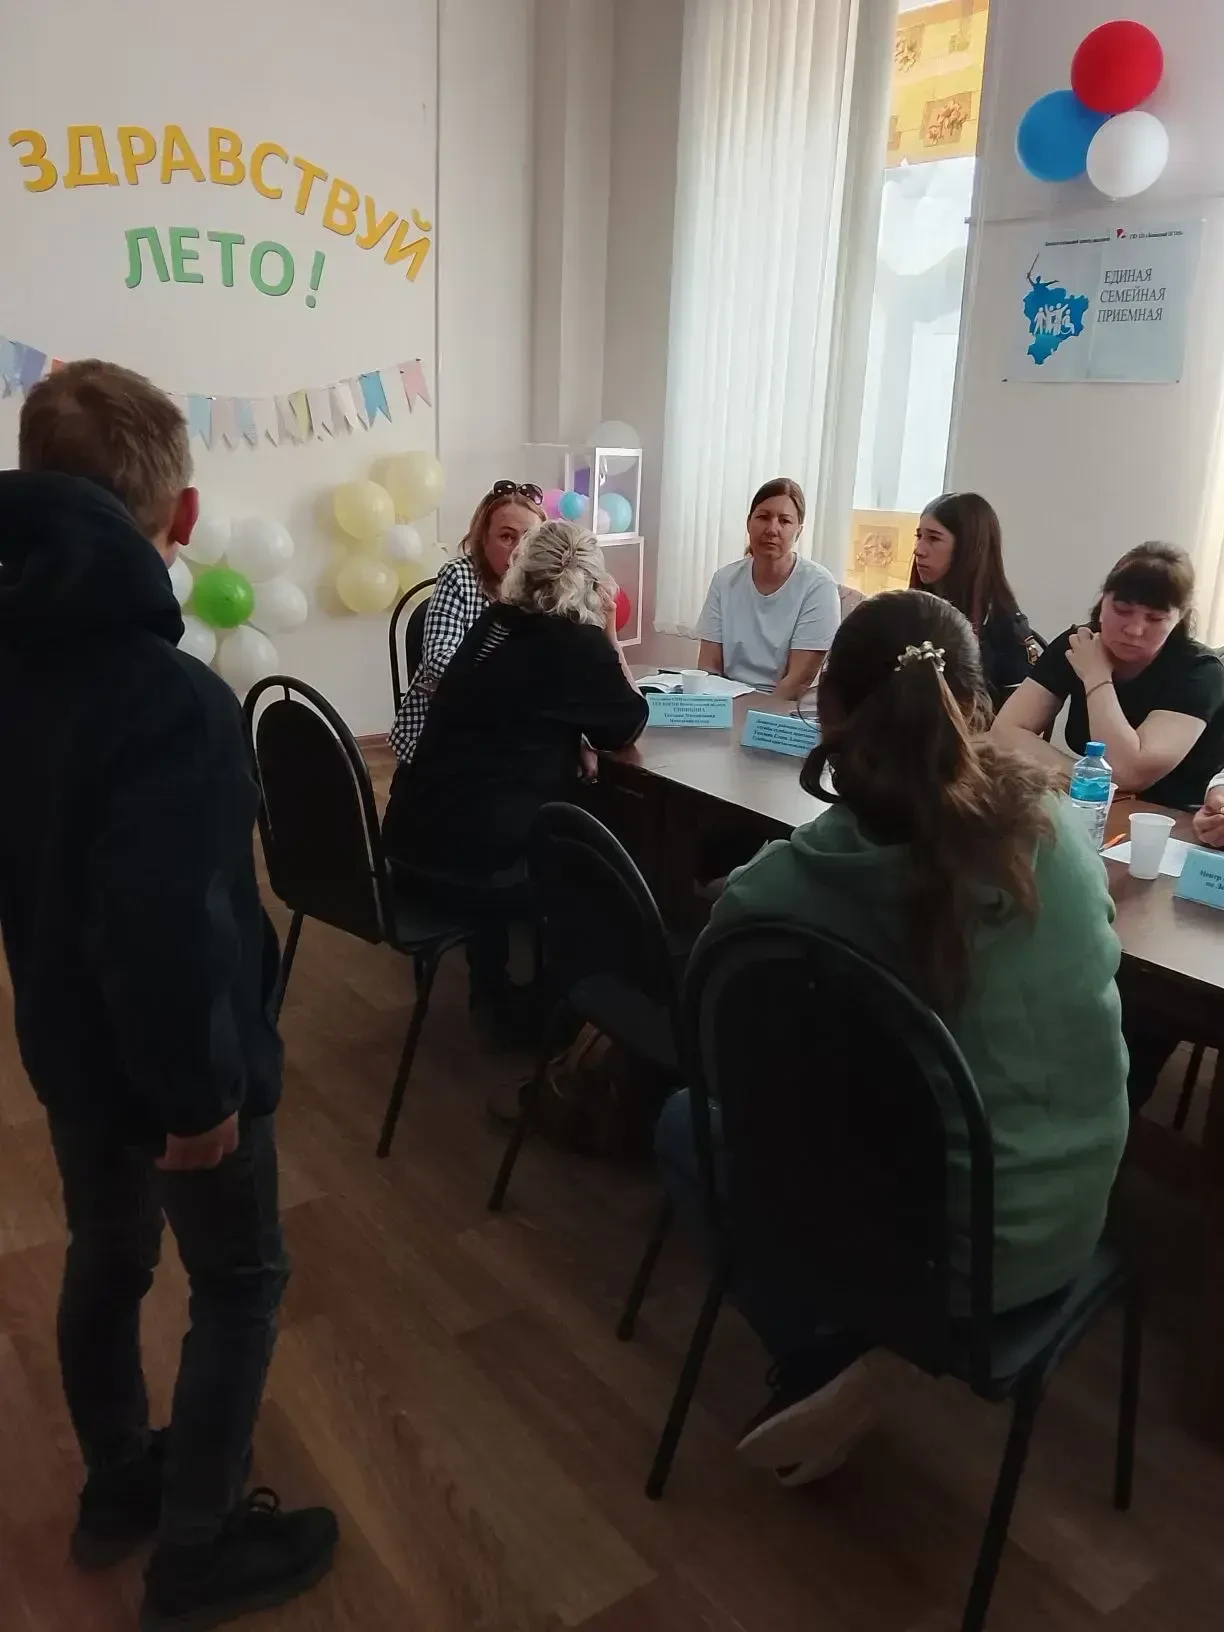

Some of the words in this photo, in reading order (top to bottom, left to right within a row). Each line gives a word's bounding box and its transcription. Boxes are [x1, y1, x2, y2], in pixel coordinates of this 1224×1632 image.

[8, 124, 432, 282] ЗДРАВСТВУЙ
[125, 226, 326, 308] ЛЕТО!
[1104, 268, 1152, 285] ЕДИНАЯ
[1100, 285, 1166, 303] СЕМЕЙНАЯ
[1097, 308, 1163, 322] ПРИЕМНАЯ
